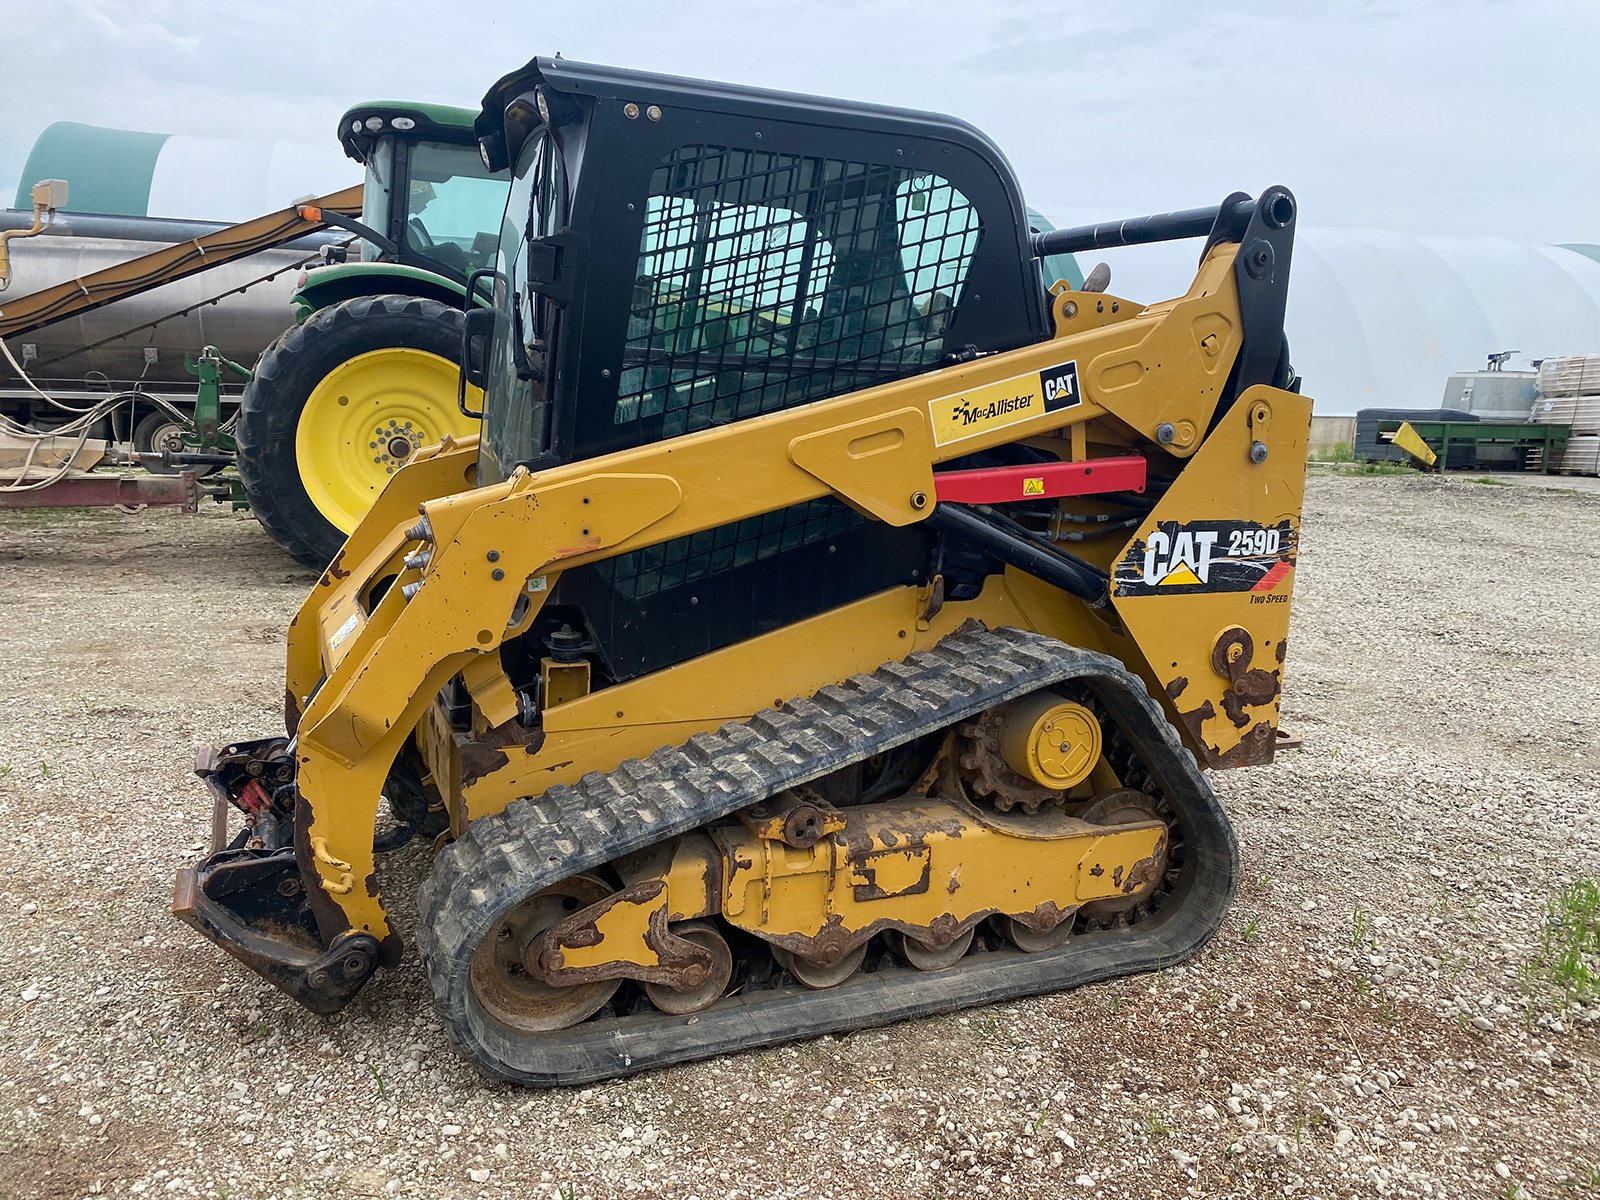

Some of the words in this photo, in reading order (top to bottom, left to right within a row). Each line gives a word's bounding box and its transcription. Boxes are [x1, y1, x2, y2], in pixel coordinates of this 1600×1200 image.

[1045, 373, 1074, 401] CAT
[962, 394, 1034, 426] MacAllister
[1144, 531, 1218, 586] CAT
[1228, 529, 1280, 556] 259D
